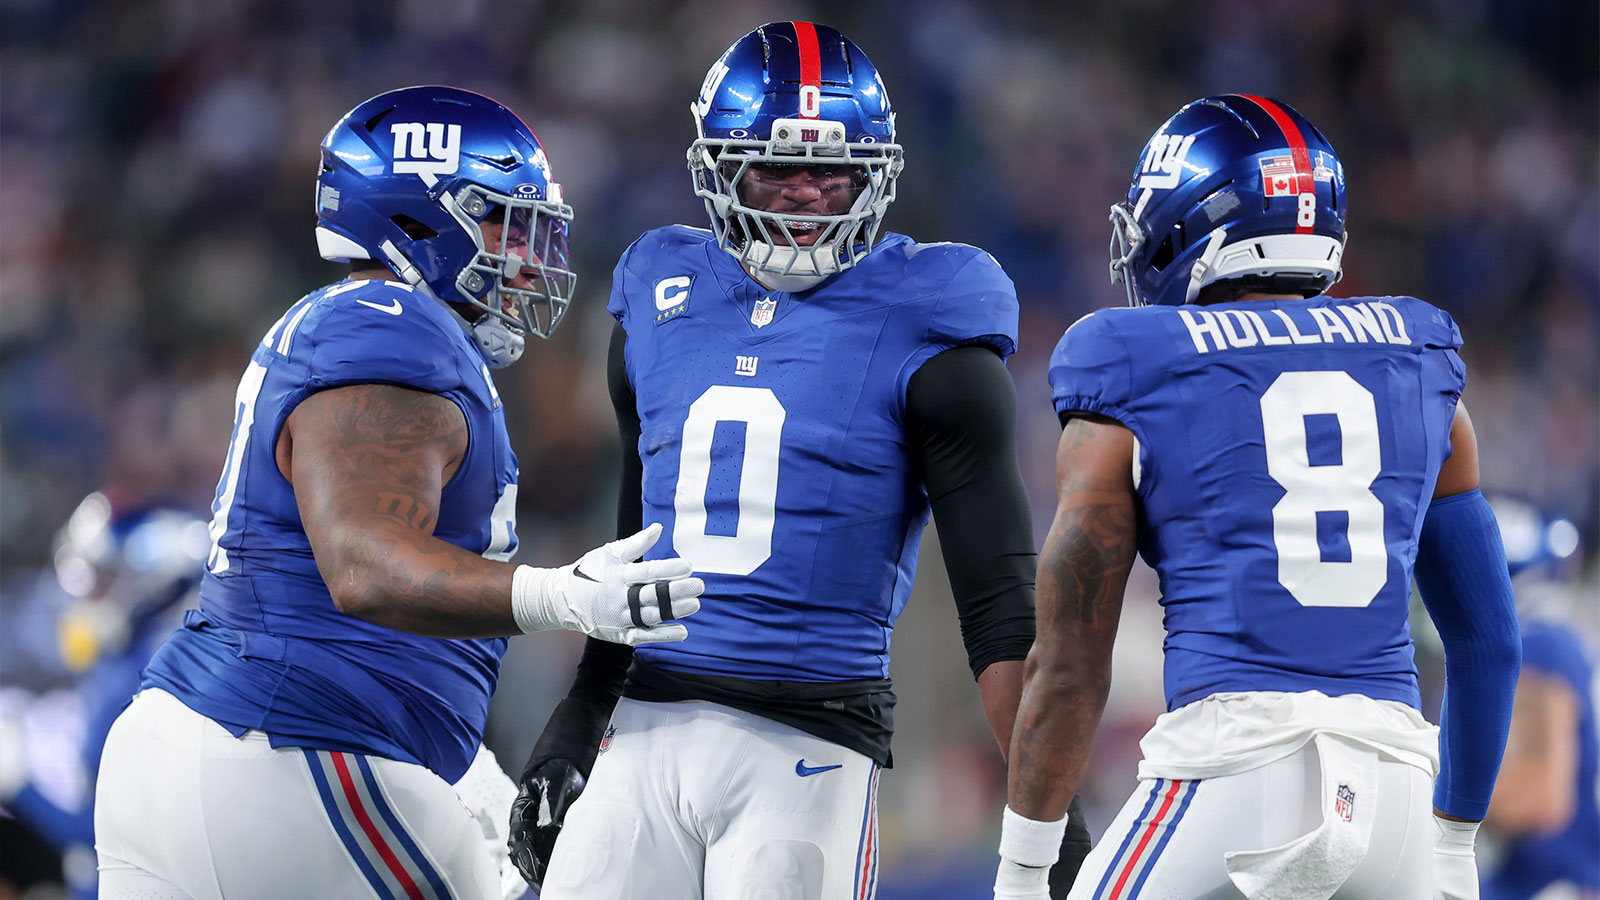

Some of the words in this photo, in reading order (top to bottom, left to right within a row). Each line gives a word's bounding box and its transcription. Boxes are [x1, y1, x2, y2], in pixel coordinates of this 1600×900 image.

[800, 85, 820, 117] 0
[390, 122, 461, 175] ny
[1297, 192, 1316, 227] 8
[655, 276, 690, 311] C
[754, 310, 769, 321] NFL
[1177, 302, 1412, 353] HOLLAND
[734, 356, 759, 377] ny
[672, 384, 787, 576] 0
[1259, 370, 1388, 608] 8
[1335, 797, 1350, 819] NFL
